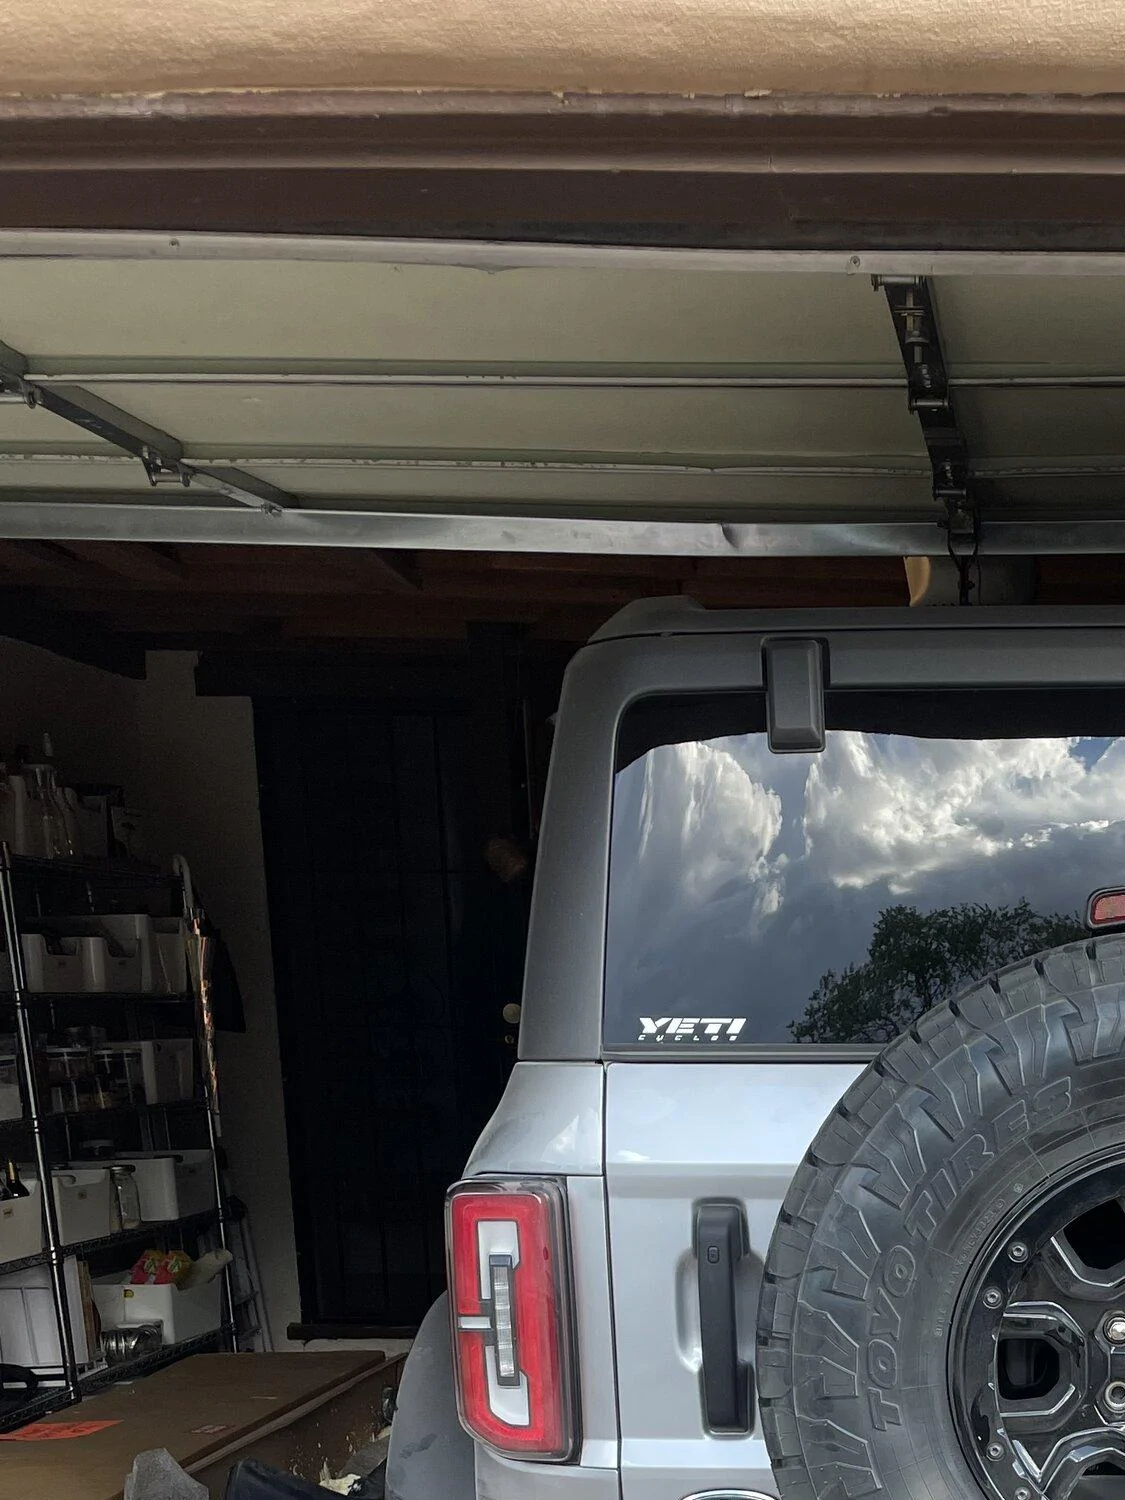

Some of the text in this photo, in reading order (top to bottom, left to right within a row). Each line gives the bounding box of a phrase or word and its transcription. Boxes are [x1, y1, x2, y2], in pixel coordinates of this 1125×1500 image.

[639, 1017, 747, 1034] YETI
[867, 1244, 916, 1432] TOYO
[903, 1076, 1072, 1242] TIRES
